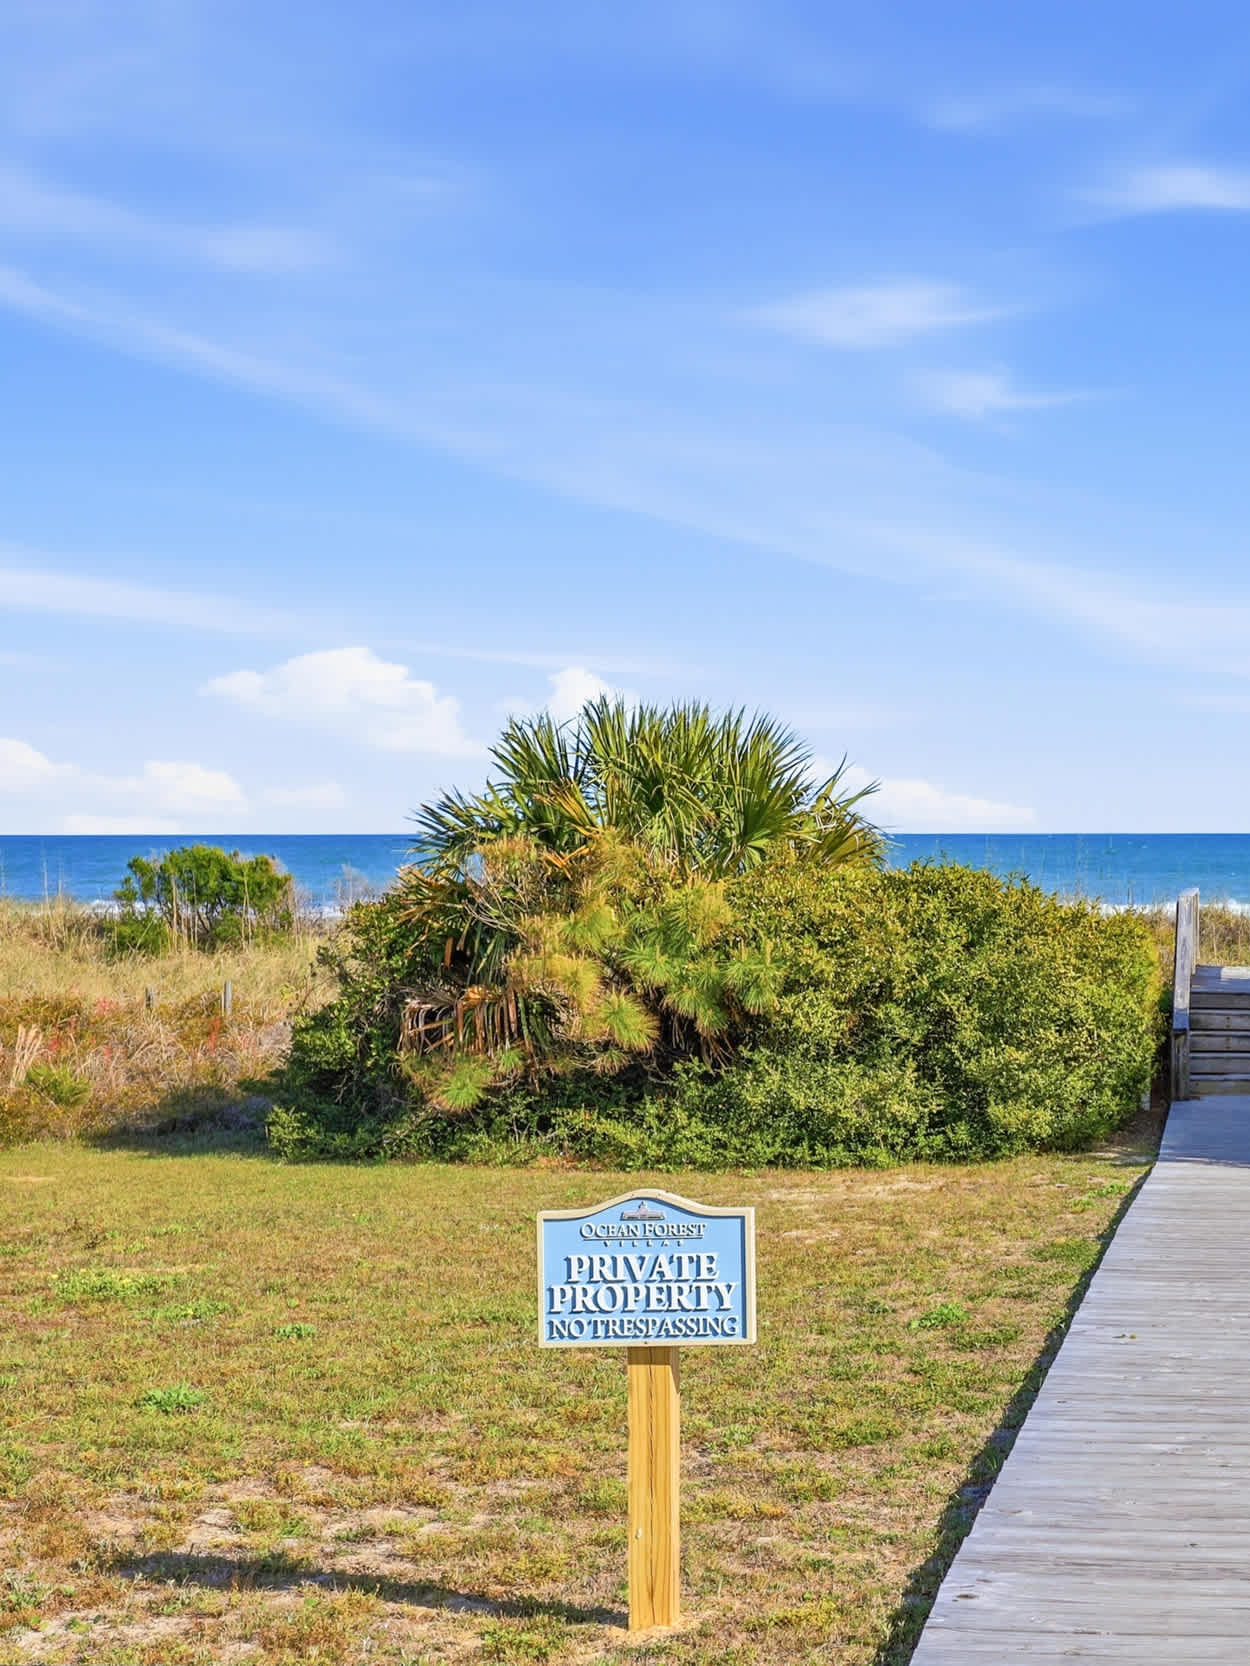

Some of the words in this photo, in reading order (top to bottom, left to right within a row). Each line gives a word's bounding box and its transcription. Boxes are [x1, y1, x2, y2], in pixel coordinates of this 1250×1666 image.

[580, 1223, 640, 1238] OCEAN
[643, 1222, 706, 1237] FOREST
[565, 1253, 719, 1283] PRIVATE
[548, 1283, 737, 1314] PROPERTY
[549, 1318, 586, 1340] NO
[588, 1316, 738, 1339] TRESPASSING
